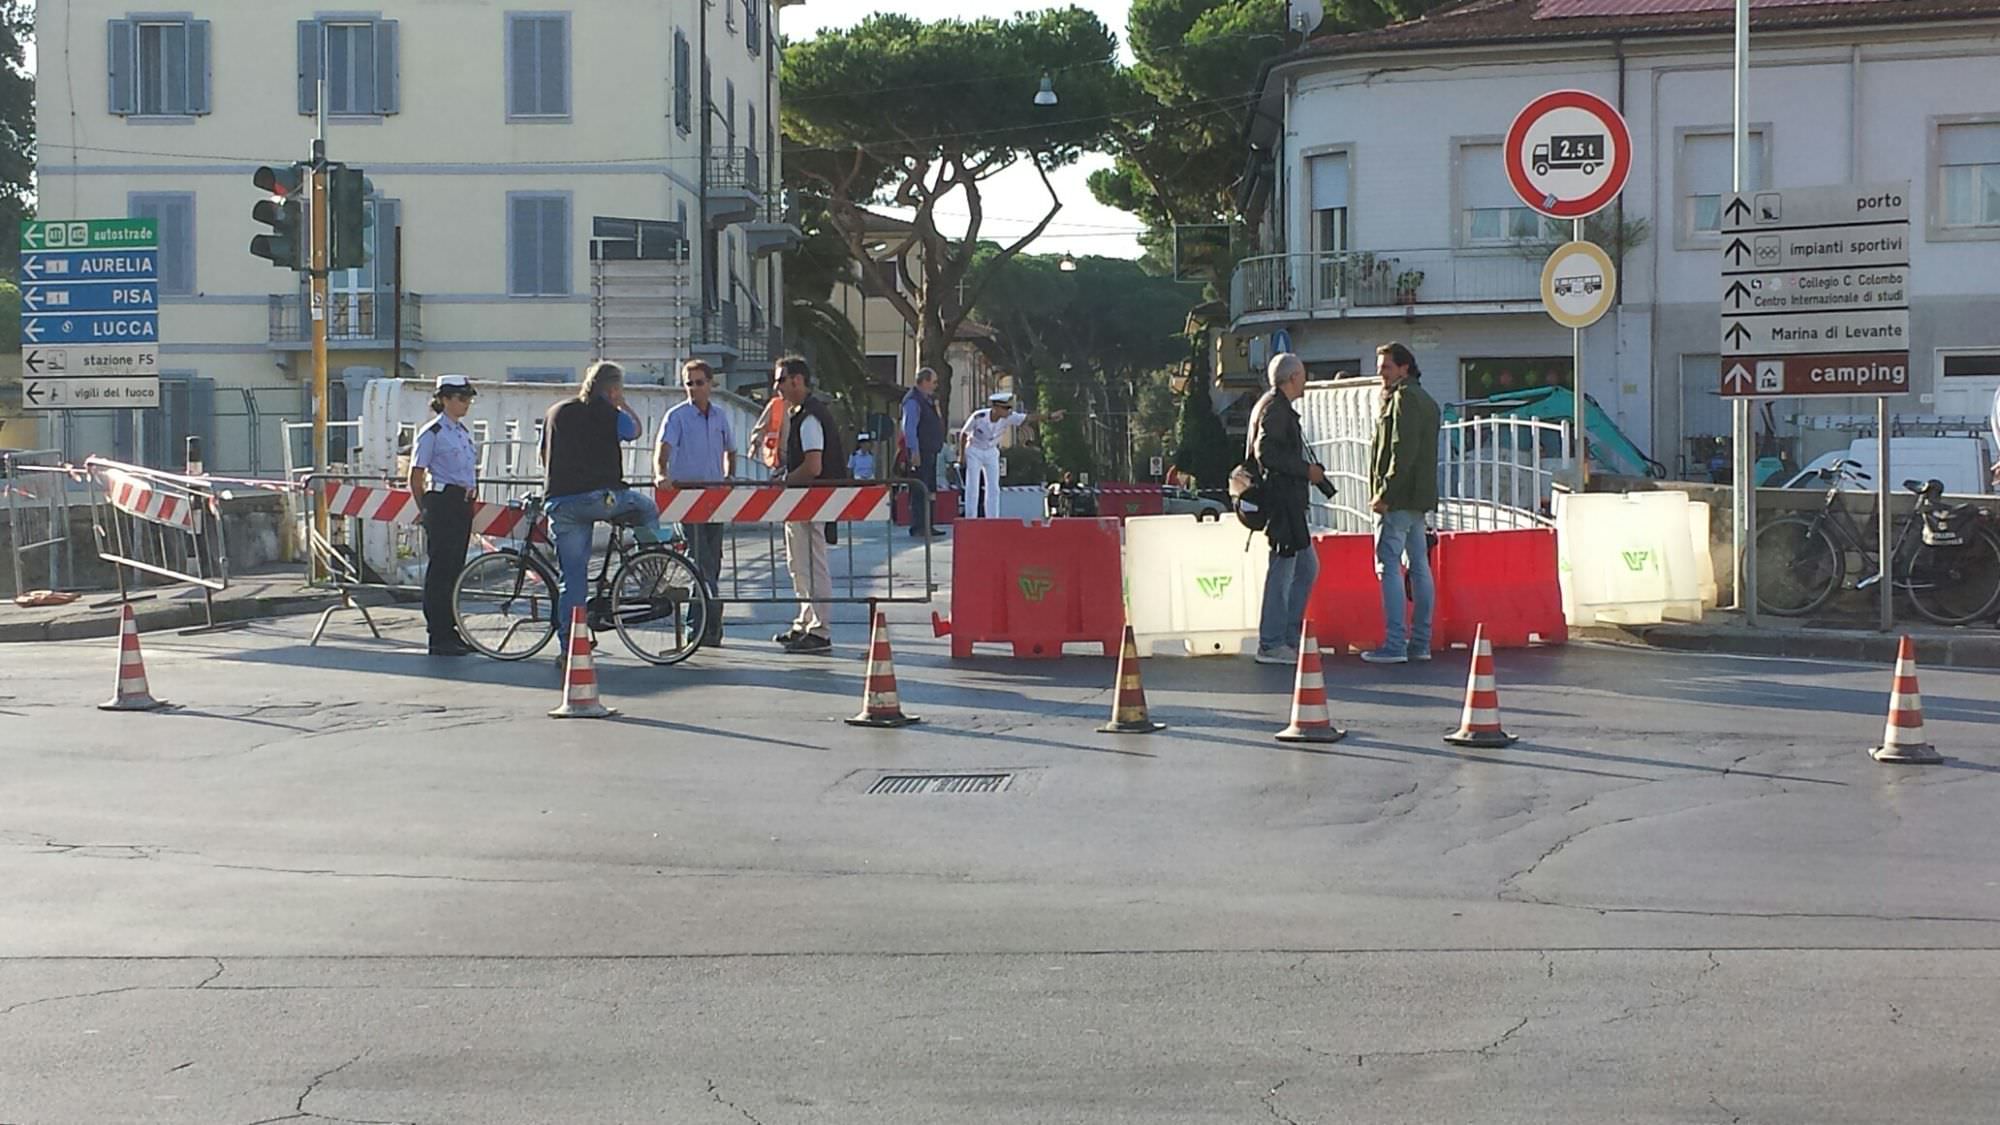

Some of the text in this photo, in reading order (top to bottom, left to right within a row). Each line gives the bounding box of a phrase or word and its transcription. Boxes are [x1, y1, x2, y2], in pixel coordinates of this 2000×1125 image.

[1857, 193, 1902, 212] porto
[94, 227, 152, 241] autostrade
[1790, 237, 1902, 257] impianti sportivi
[81, 257, 152, 273] AURELIA
[1799, 275, 1839, 291] Collegio
[1858, 273, 1903, 286] Colombo
[112, 289, 152, 304] PISA
[1754, 288, 1903, 307] Centro Internazionale di studi
[93, 321, 154, 337] LUCCA
[1771, 324, 1902, 341] Marina di Levante
[83, 353, 154, 366] stazione FS
[1810, 363, 1905, 386] camping
[75, 386, 154, 400] vigili del fuoco
